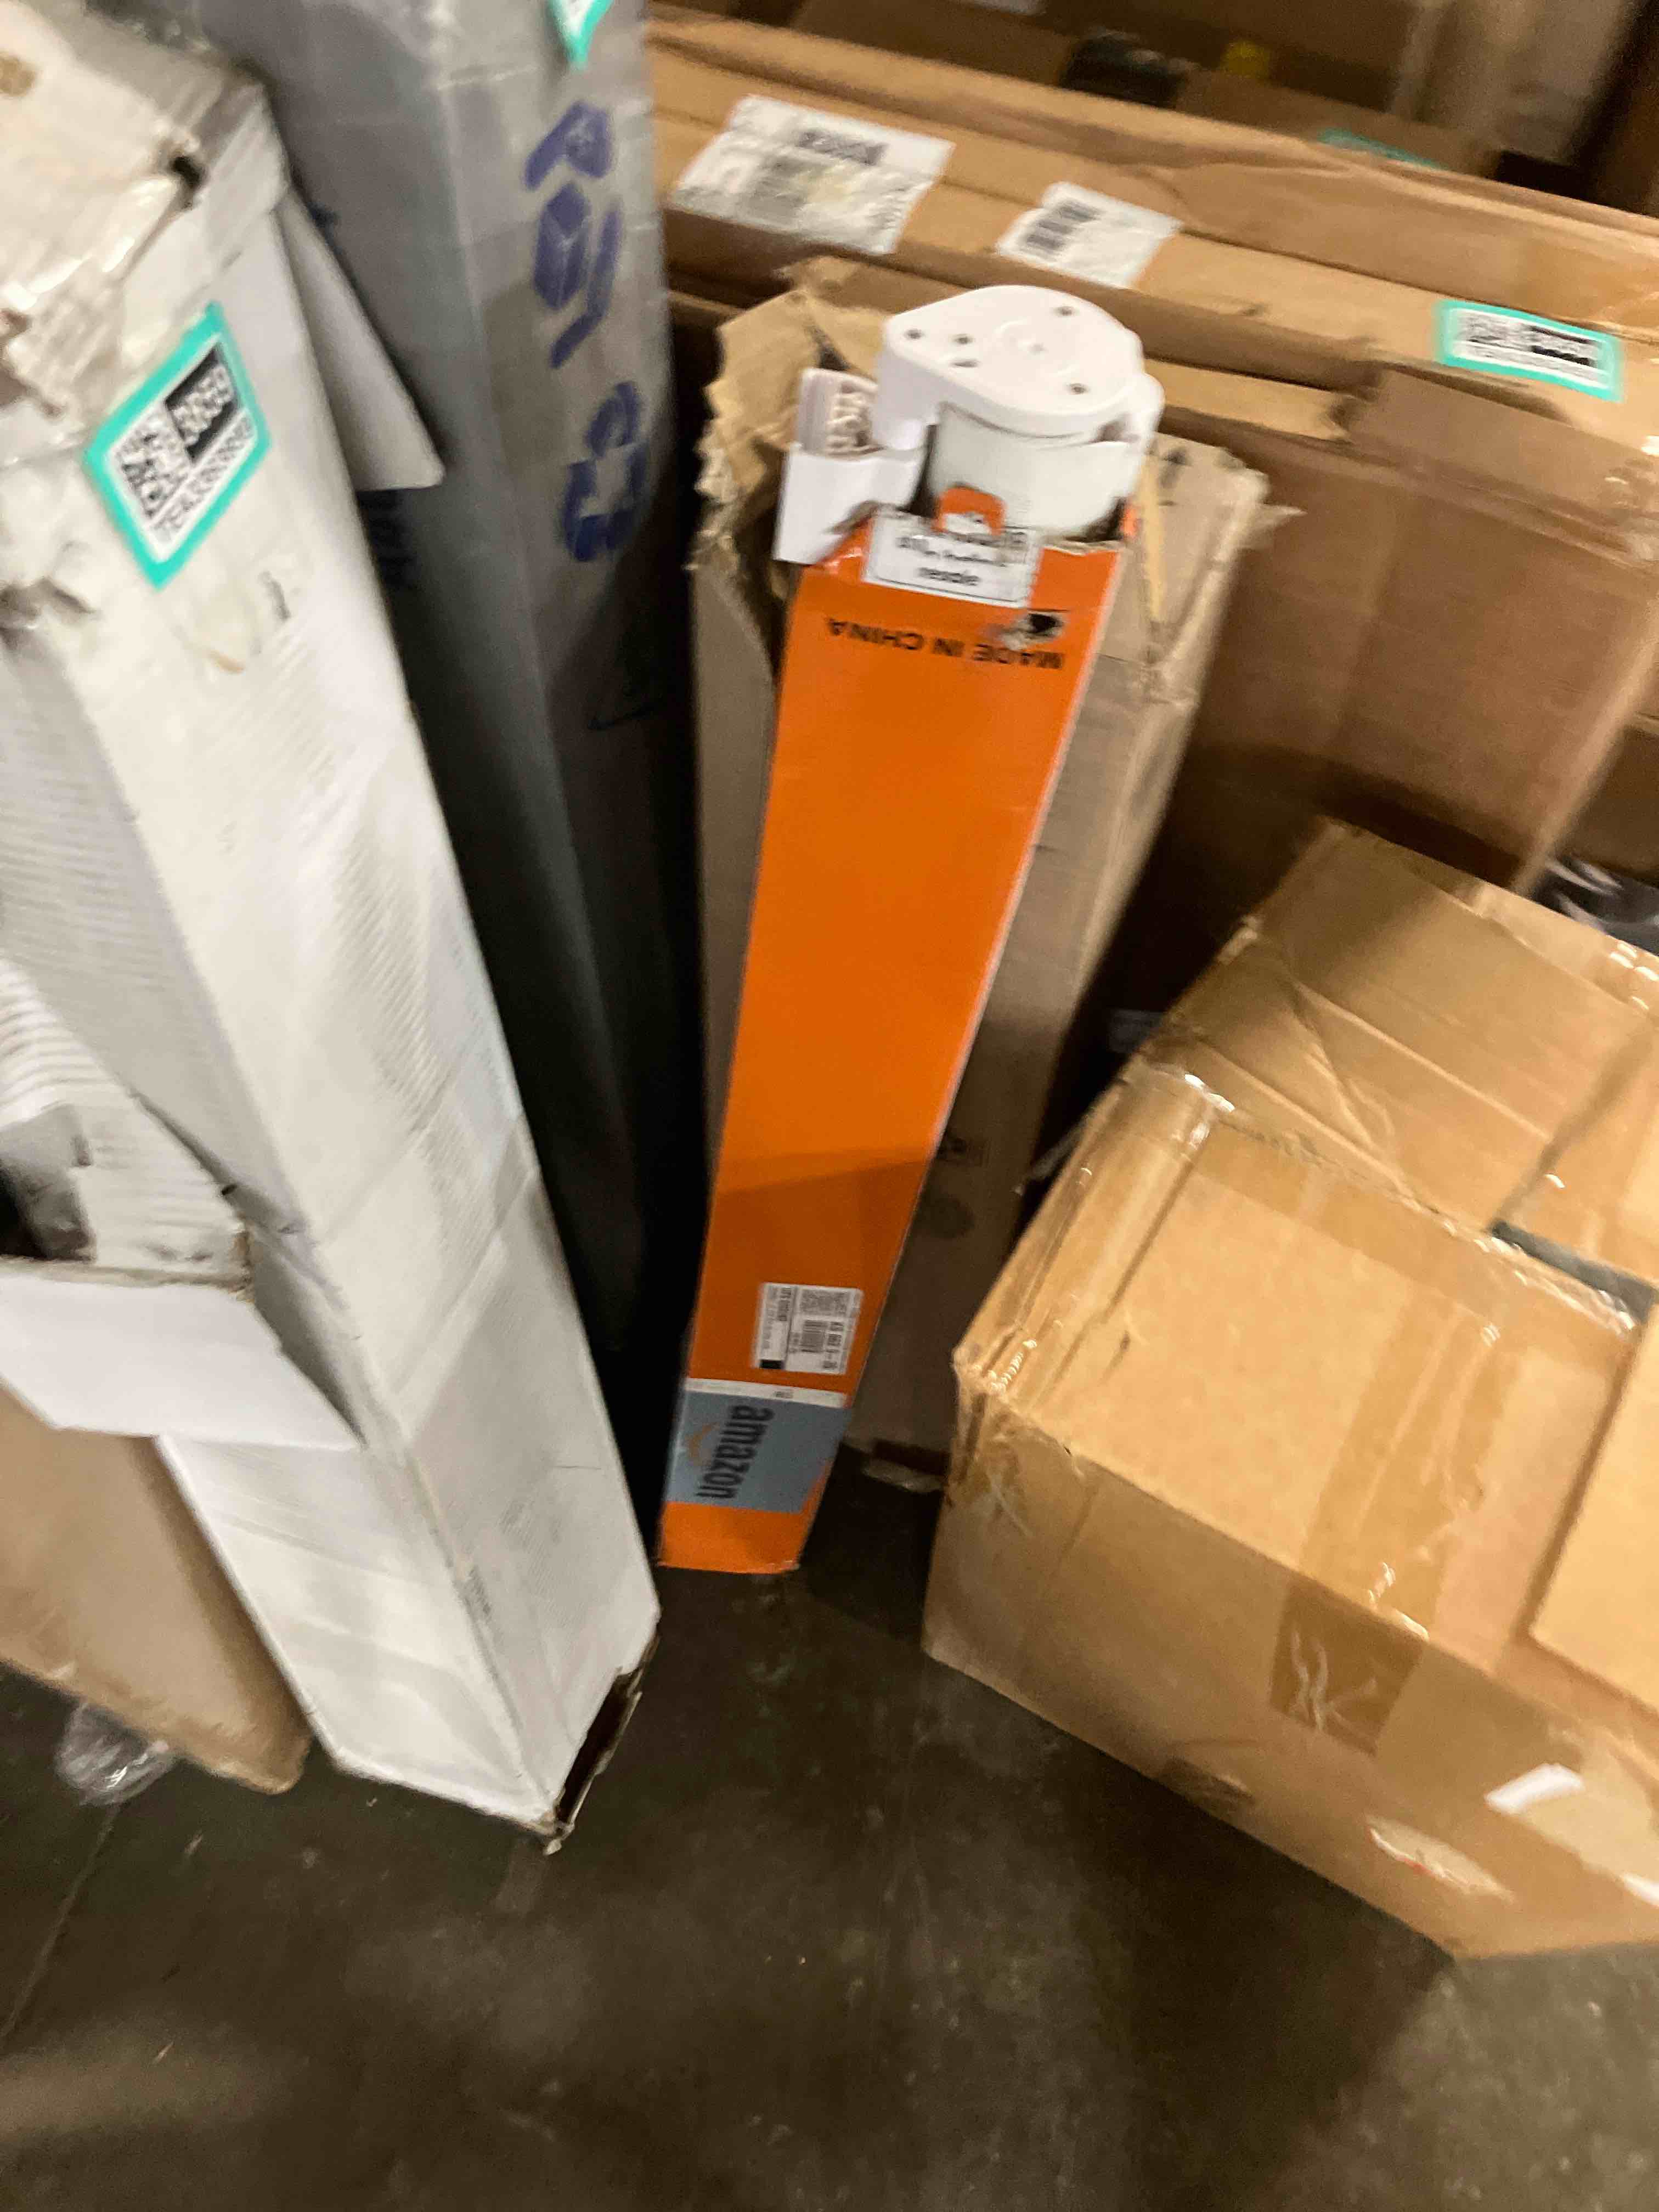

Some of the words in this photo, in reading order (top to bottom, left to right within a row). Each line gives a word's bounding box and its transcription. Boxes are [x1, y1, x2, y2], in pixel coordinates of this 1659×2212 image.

[827, 617, 924, 651] CHINA
[932, 634, 965, 658] IN
[974, 644, 1064, 669] MADE
[696, 1404, 774, 1500] amazon
